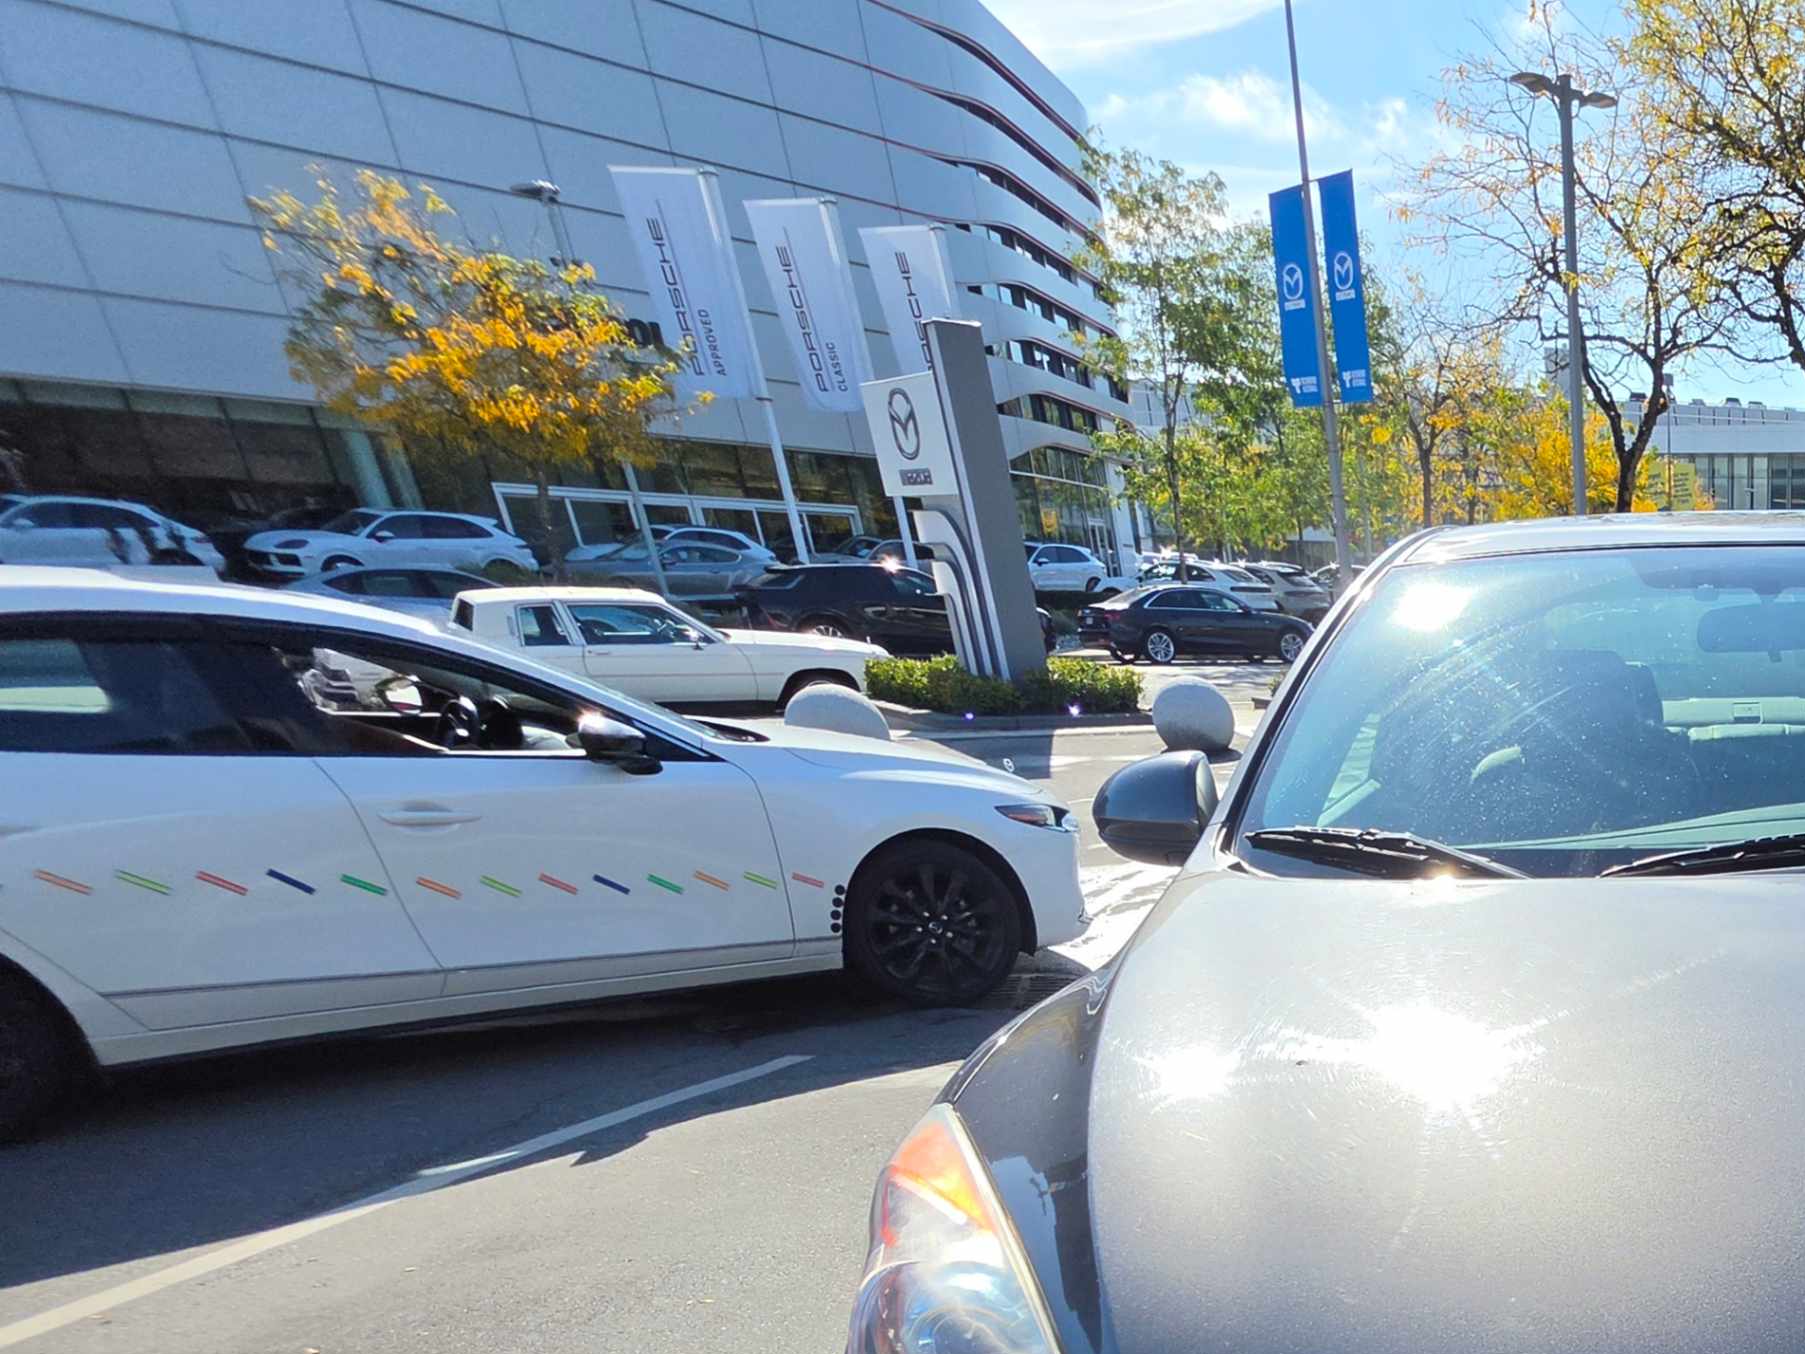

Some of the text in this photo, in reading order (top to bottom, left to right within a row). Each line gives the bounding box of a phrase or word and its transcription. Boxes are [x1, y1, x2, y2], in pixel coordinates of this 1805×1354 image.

[646, 216, 705, 377] PORSCHE
[697, 308, 728, 377] APPROVED
[775, 245, 829, 393] PORSCHE
[825, 341, 849, 392] CLASSIC
